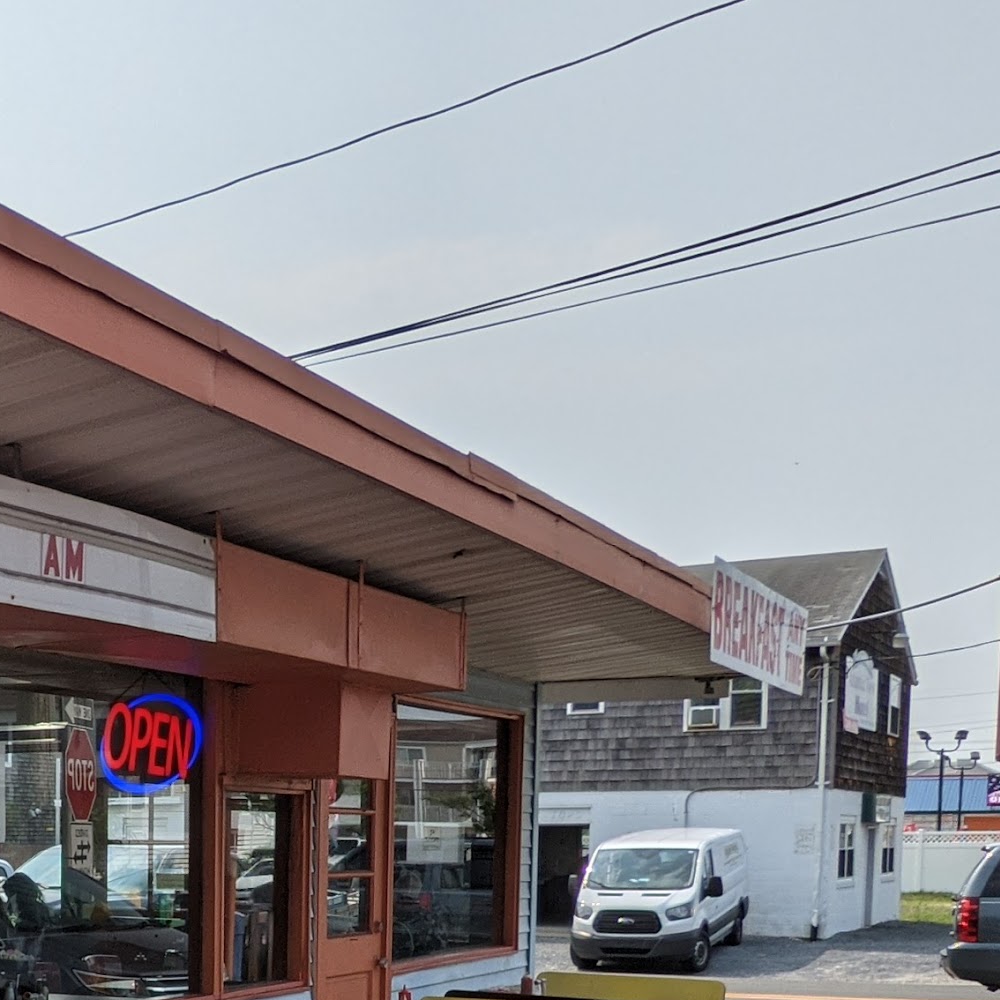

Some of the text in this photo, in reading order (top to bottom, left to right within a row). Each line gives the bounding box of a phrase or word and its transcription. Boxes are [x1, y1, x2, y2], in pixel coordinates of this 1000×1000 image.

[43, 534, 84, 582] AM
[714, 570, 785, 677] BREAKFAST
[103, 702, 193, 780] OPEN
